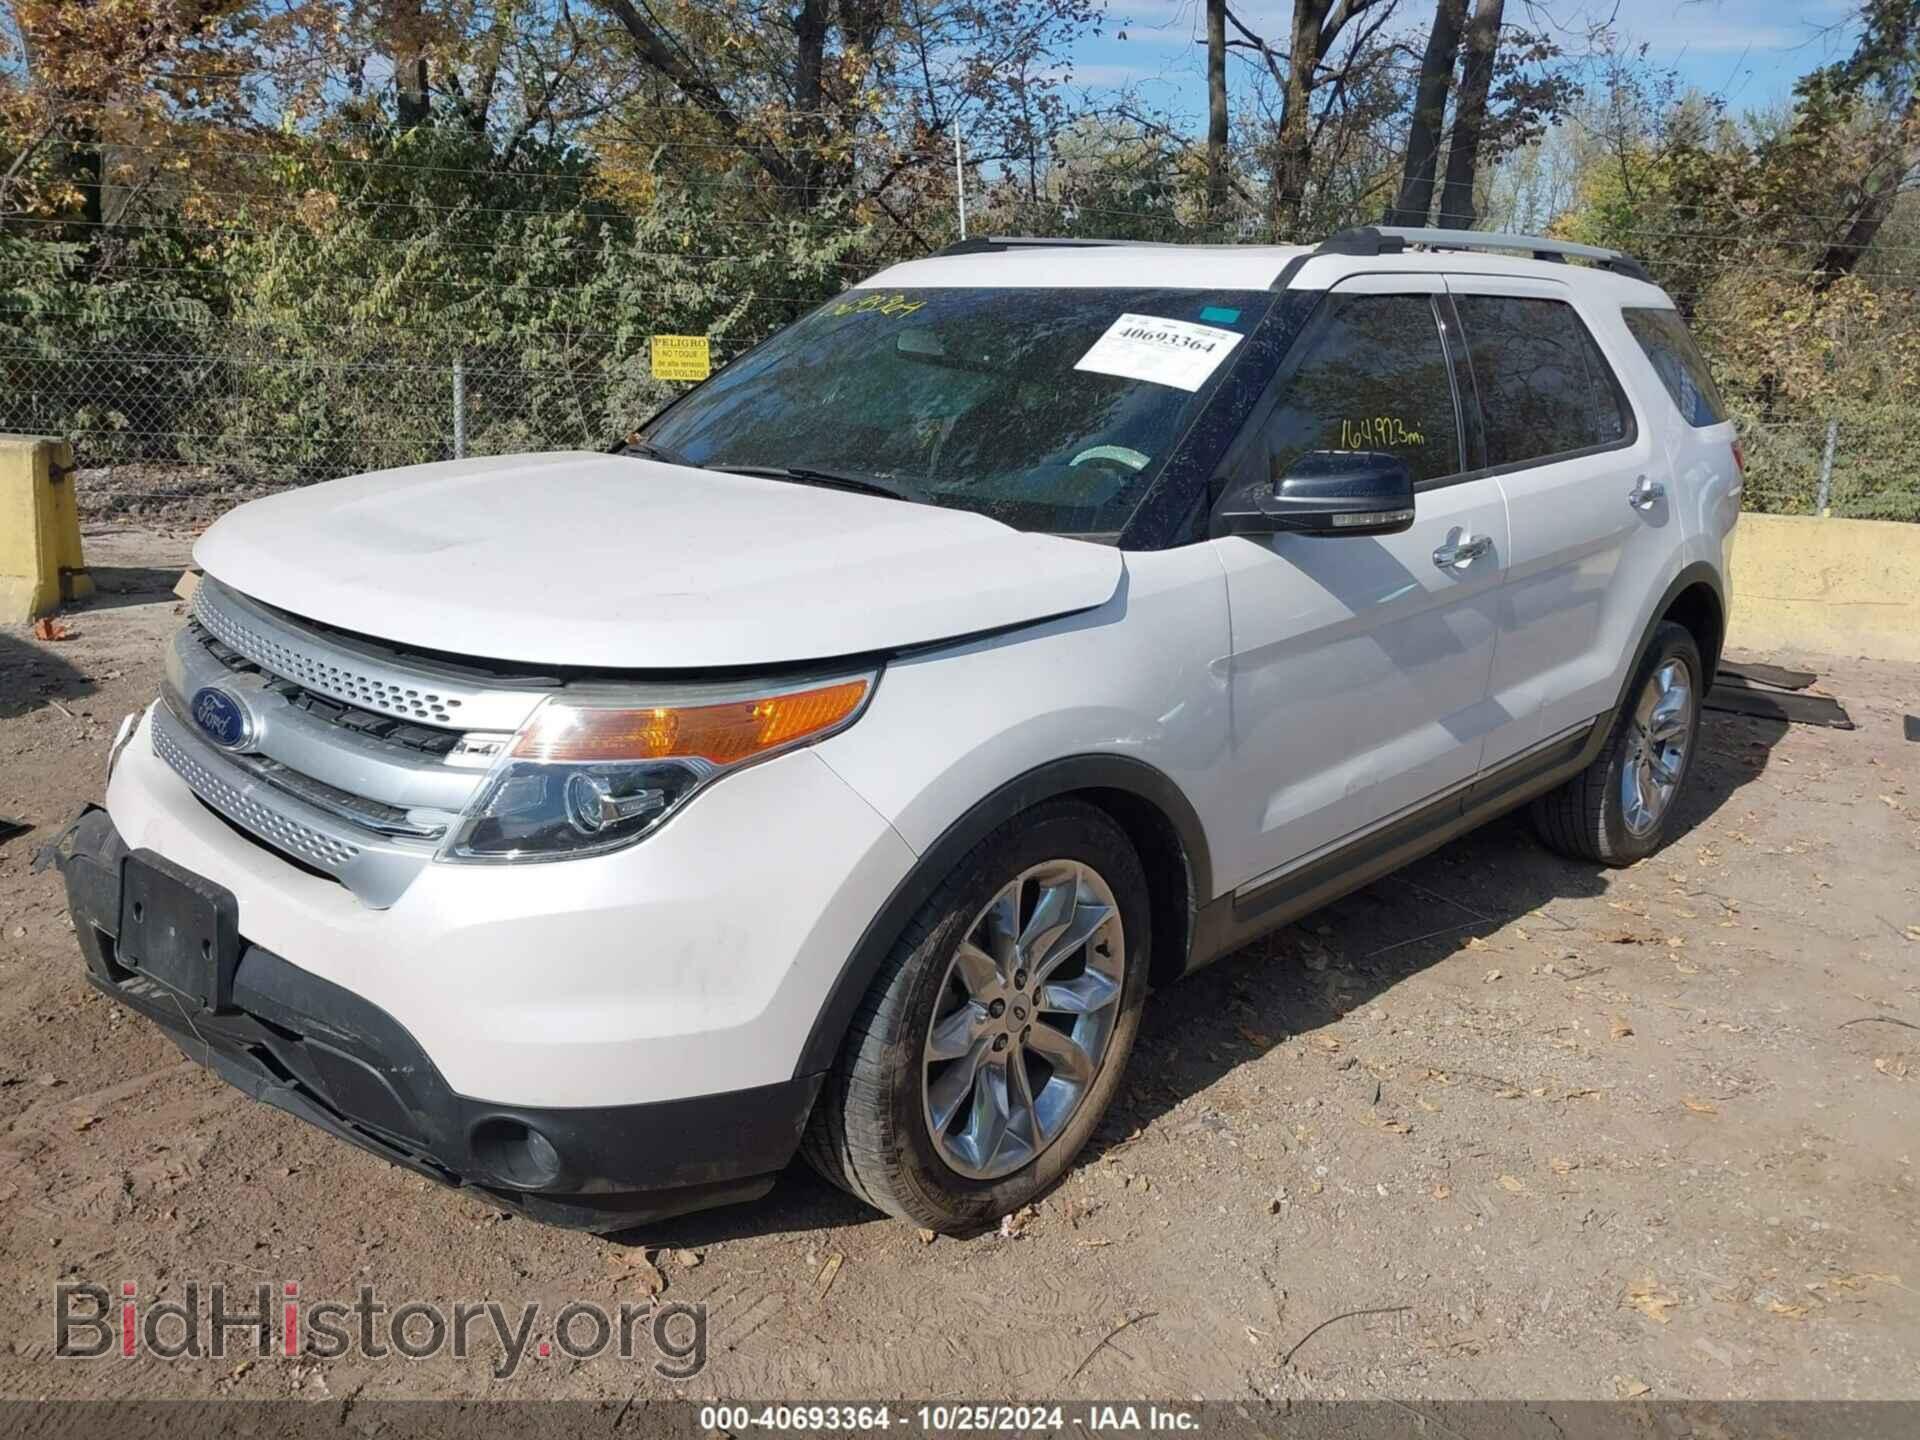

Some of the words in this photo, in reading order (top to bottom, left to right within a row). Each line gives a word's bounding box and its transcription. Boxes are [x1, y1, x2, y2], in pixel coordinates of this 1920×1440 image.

[655, 337, 706, 347] PELIGRO
[1119, 327, 1217, 353] 40693364
[198, 694, 232, 736] Ford
